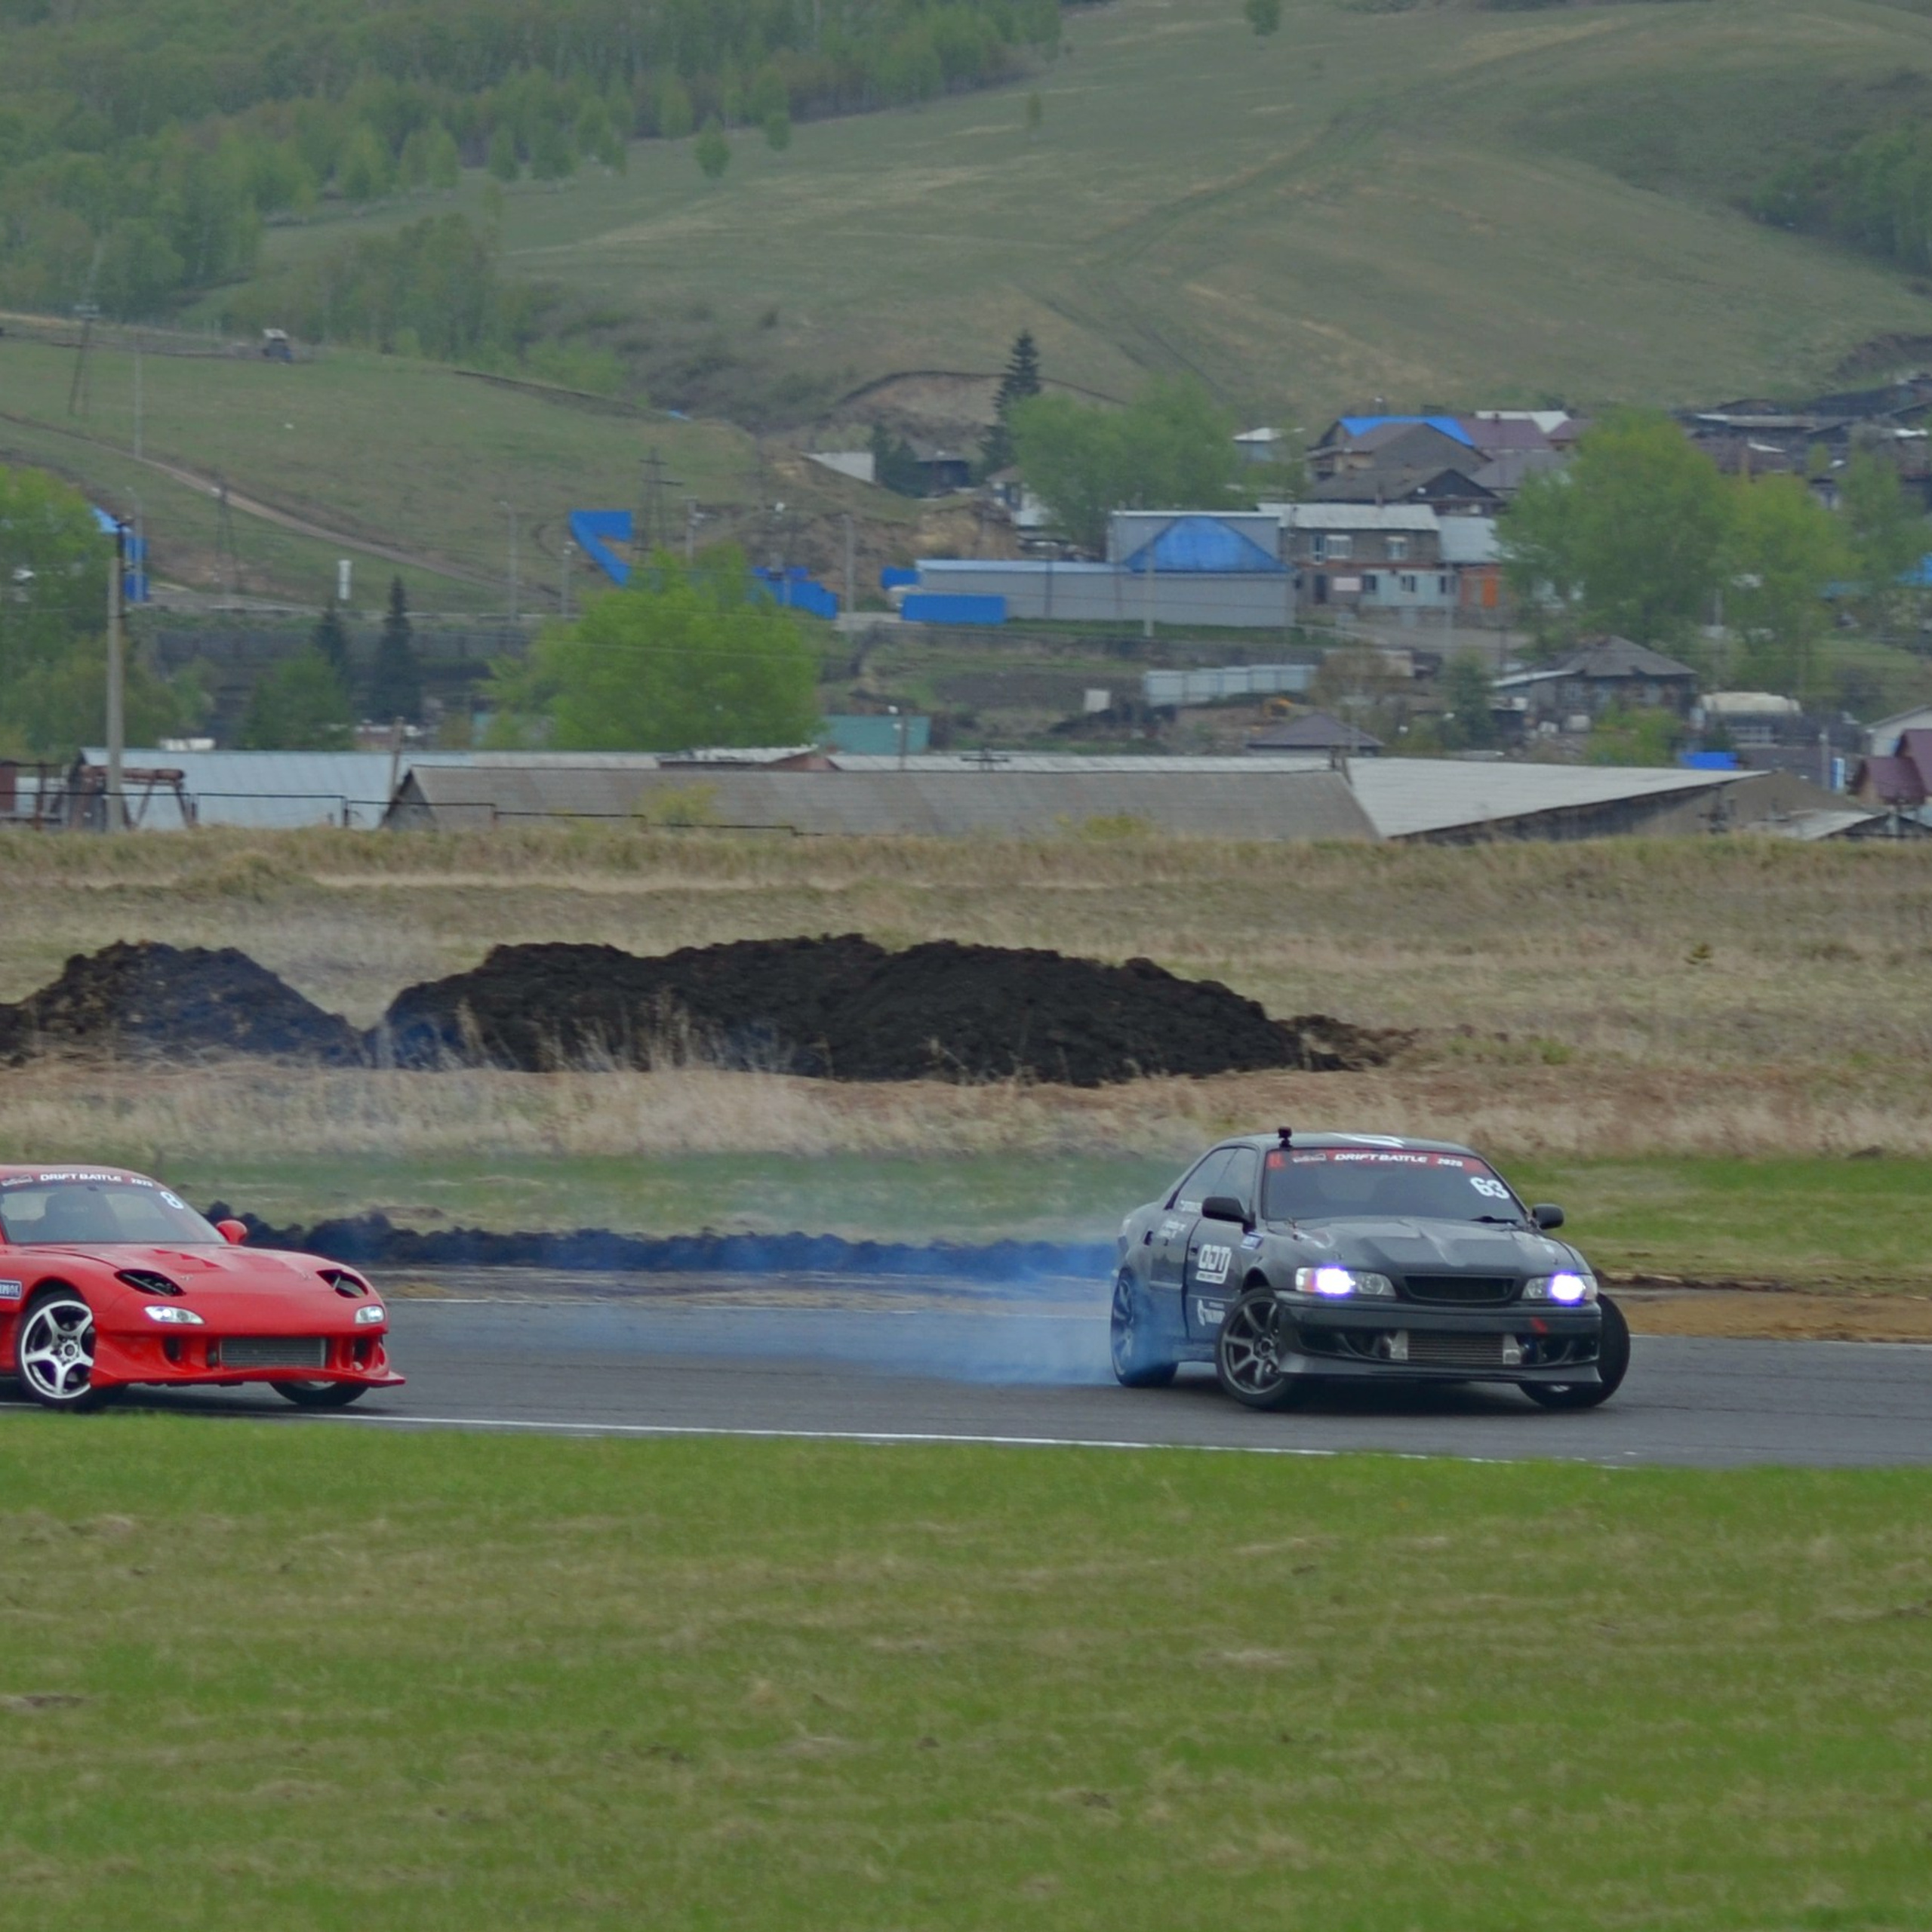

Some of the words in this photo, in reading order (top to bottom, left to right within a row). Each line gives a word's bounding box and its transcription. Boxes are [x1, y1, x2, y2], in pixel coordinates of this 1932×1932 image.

[1334, 1153, 1377, 1161] DRIFT
[1380, 1154, 1428, 1163] BATTLE
[40, 1173, 77, 1182] DRIFT
[79, 1173, 122, 1182] BATTLE
[1470, 1177, 1510, 1199] 63
[160, 1191, 184, 1209] 8
